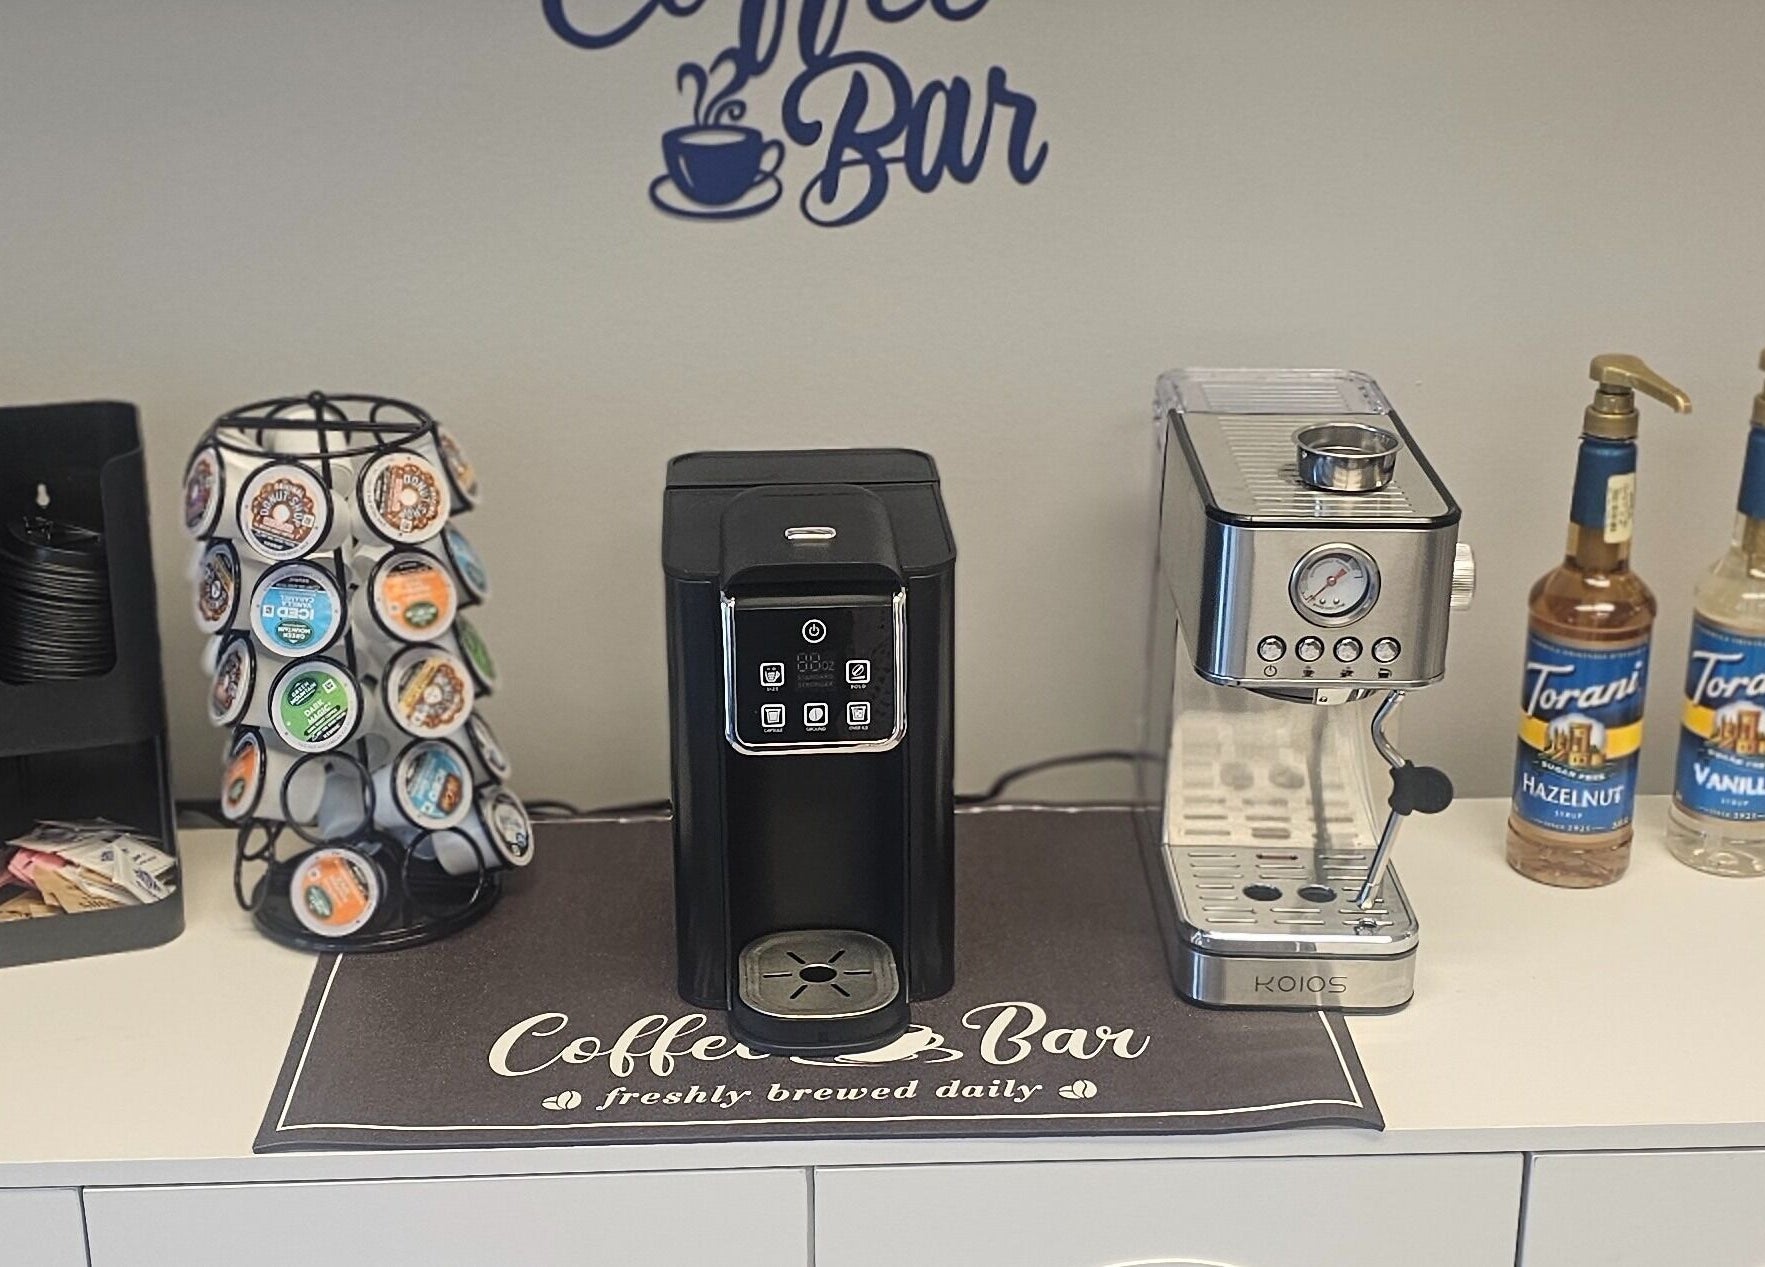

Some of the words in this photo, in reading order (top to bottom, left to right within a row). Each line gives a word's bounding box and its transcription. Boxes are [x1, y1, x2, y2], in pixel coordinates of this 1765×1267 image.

[782, 50, 1048, 227] Bar
[260, 488, 289, 516] DONUT
[277, 606, 315, 621] ICED
[277, 626, 312, 635] MOUNTAIN
[282, 632, 306, 640] GREEN
[289, 682, 318, 706] MOUNTAIN
[291, 681, 310, 698] GREEN
[1526, 660, 1643, 717] Torani
[303, 699, 325, 718] DARK
[1541, 760, 1577, 778] SUGAR
[1578, 772, 1606, 781] FREE
[1523, 772, 1625, 808] HAZELNUT
[1554, 809, 1583, 819] SYRUP
[1254, 975, 1348, 994] KOIOS
[961, 1001, 1151, 1066] Bar
[595, 1085, 752, 1112] freshly
[766, 1080, 920, 1102] brewed
[935, 1079, 1044, 1103] daily
